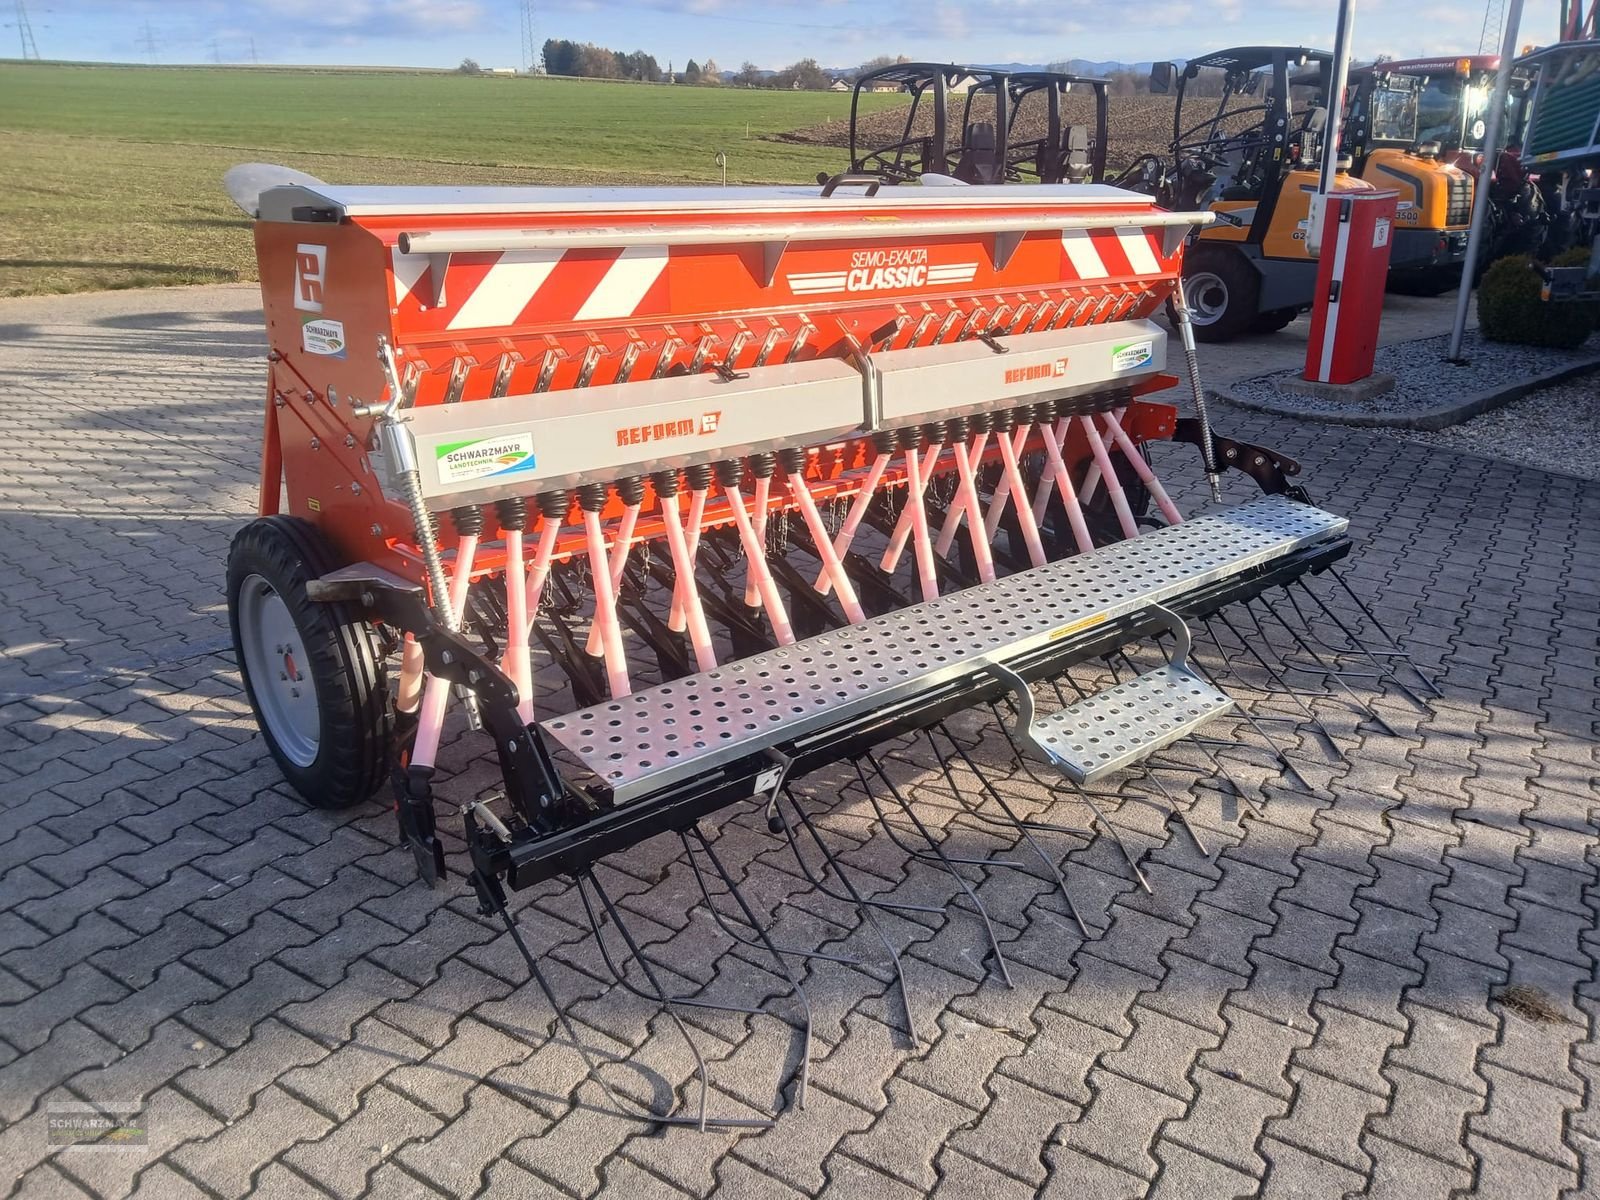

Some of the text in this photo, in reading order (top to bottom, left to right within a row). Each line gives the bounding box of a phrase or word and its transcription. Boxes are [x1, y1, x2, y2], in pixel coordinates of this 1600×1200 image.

[850, 249, 928, 268] SEMO-EXACTA
[847, 265, 927, 292] CLASSIC
[1005, 363, 1051, 384] REFORM
[616, 418, 694, 447] REFORM
[446, 443, 521, 463] SCHWARZMAYR
[449, 457, 494, 470] LANDTECHNIK
